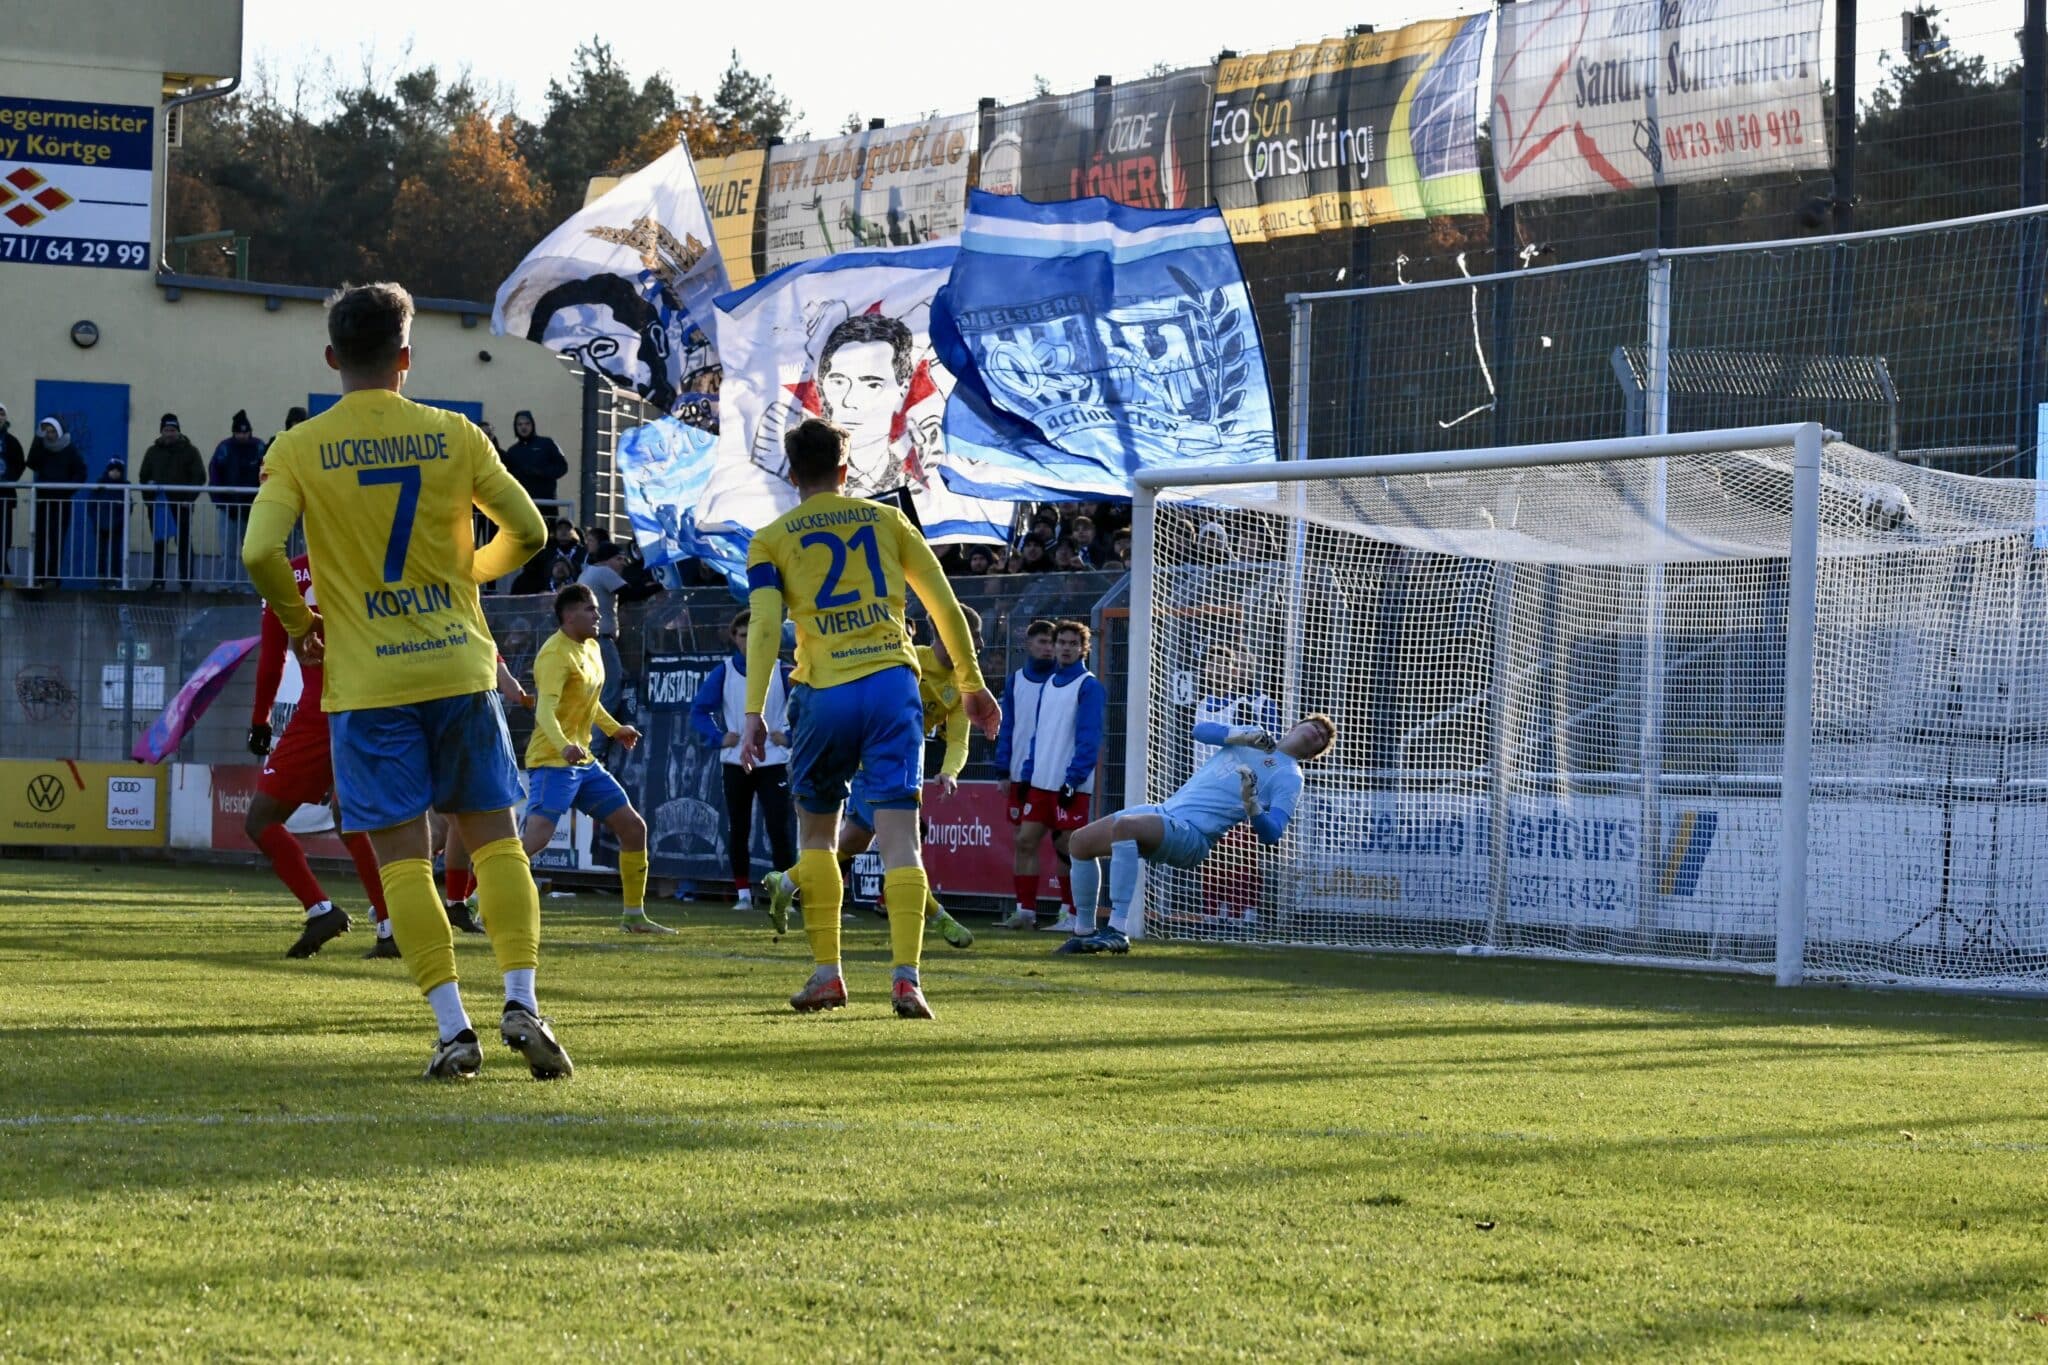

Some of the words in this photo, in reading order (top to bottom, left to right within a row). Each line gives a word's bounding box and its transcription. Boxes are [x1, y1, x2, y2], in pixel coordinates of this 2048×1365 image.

[0, 109, 147, 133] egermeister
[27, 134, 111, 164] Körtge
[1244, 117, 1370, 182] Consulting
[46, 240, 74, 261] 64
[82, 243, 109, 262] 29
[117, 245, 145, 264] 99
[319, 432, 450, 471] LUCKENWALDE
[357, 464, 422, 584] 7
[785, 507, 881, 534] LUCKENWALDE
[800, 525, 889, 610] 21
[364, 582, 452, 620] KOPLIN
[815, 603, 891, 636] VIERLIN
[376, 637, 448, 657] Märkischer
[831, 644, 883, 660] Märkischer
[111, 817, 151, 827] Service
[112, 807, 139, 816] Audi
[924, 815, 991, 853] burgische
